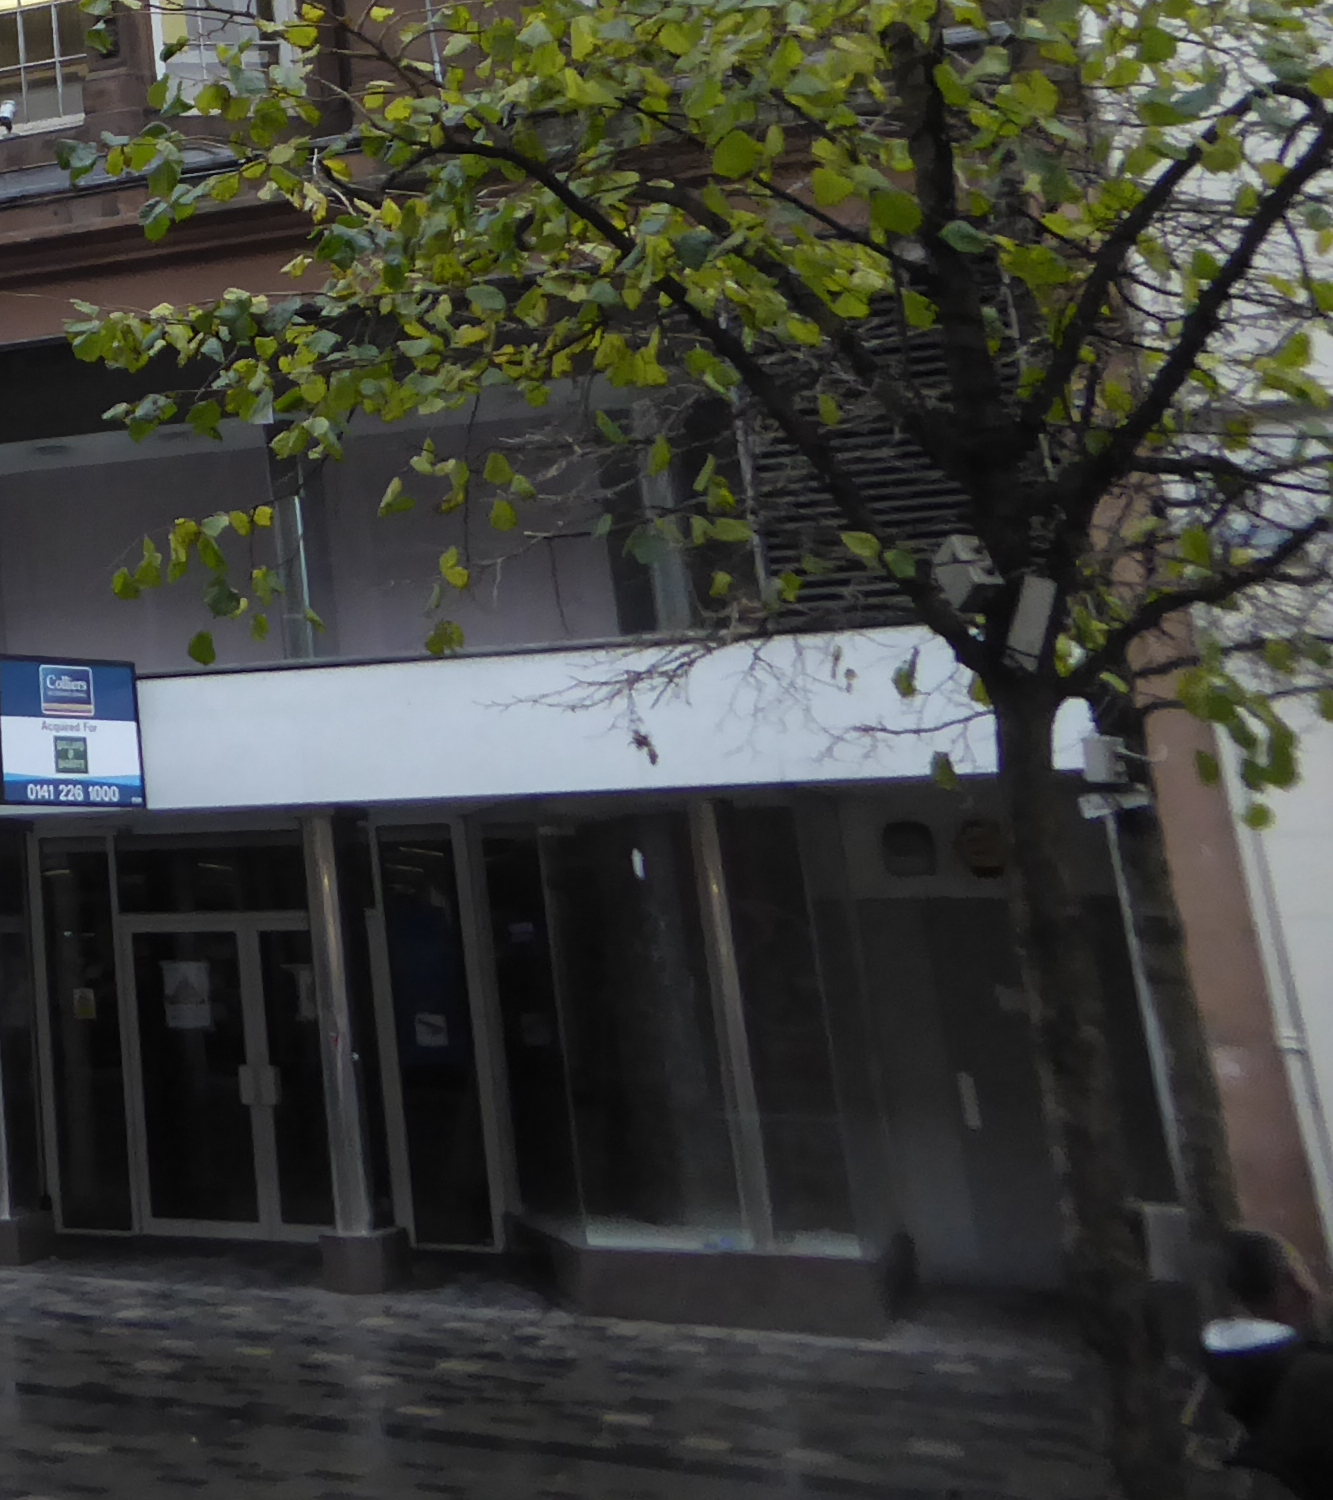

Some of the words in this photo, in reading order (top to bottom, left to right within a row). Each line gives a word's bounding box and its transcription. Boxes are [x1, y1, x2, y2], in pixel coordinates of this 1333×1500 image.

[46, 674, 88, 691] Colliers
[41, 720, 81, 733] Acquired
[27, 783, 55, 800] 0141
[59, 784, 84, 801] 226
[88, 785, 120, 802] 1000
